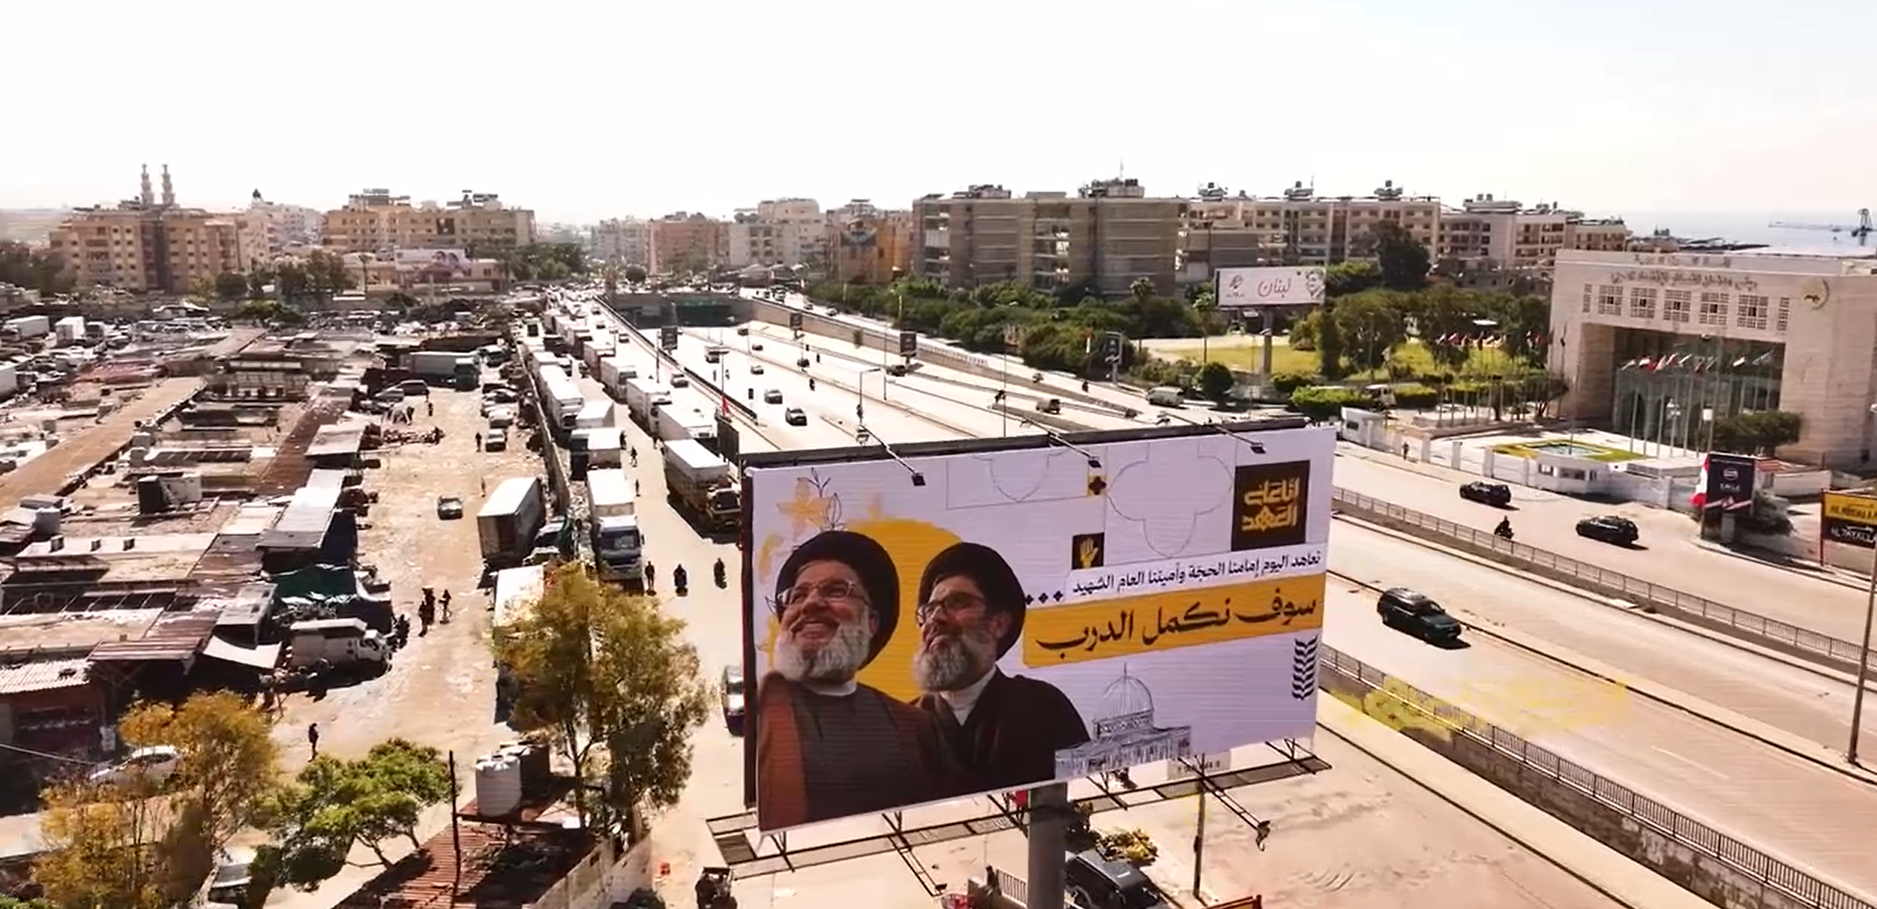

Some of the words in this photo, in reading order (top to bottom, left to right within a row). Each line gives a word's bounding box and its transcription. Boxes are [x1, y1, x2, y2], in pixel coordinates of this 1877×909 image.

[1257, 277, 1292, 299] لبنان
[1228, 557, 1261, 579] إمامنا
[1262, 554, 1290, 576] اليوم
[1291, 550, 1321, 568] نعاهد
[1073, 574, 1115, 597] الشهيد
[1117, 571, 1146, 593] العام
[1236, 586, 1317, 627] سوف
[1142, 597, 1231, 646] نكمل
[1035, 609, 1135, 660] الدرب
